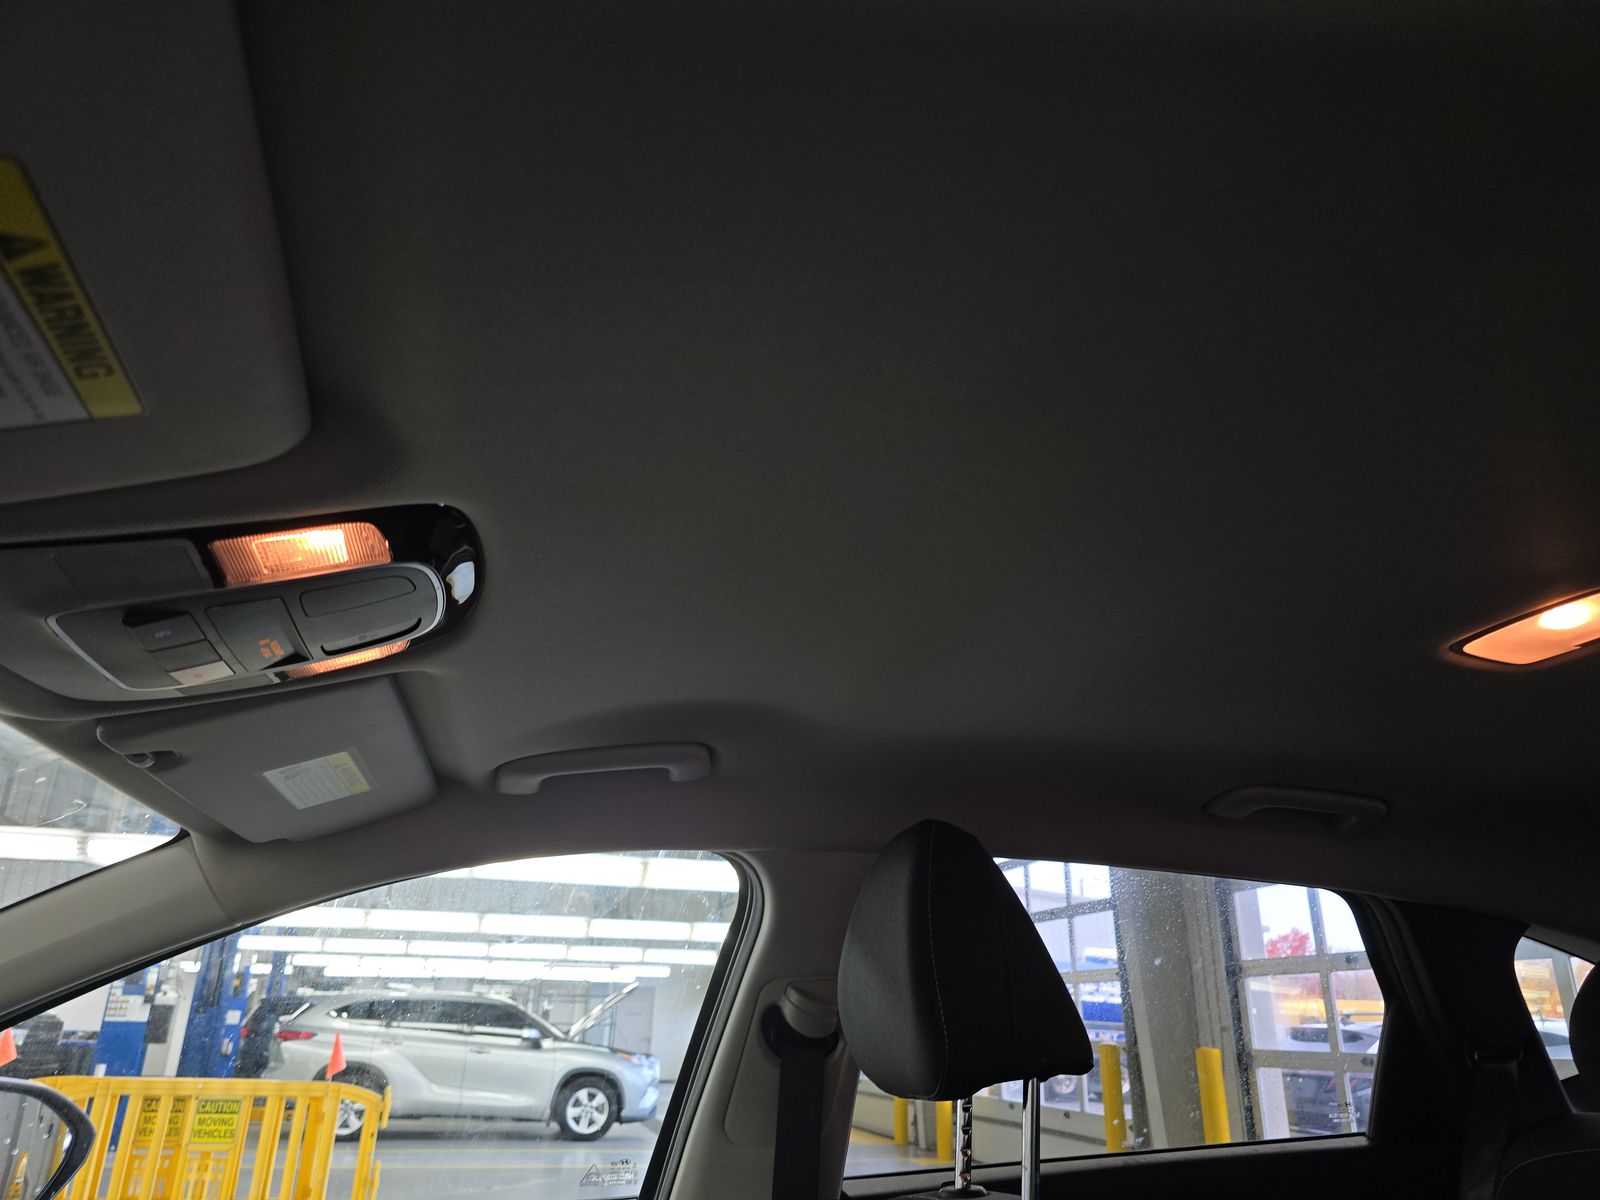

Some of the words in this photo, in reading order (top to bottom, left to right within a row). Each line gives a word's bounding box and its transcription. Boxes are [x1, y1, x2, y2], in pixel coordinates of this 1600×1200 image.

[18, 264, 115, 381] WARNING
[198, 1101, 241, 1112] CAUTION
[197, 1116, 234, 1126] MOVING
[192, 1128, 235, 1138] VEHICLES
